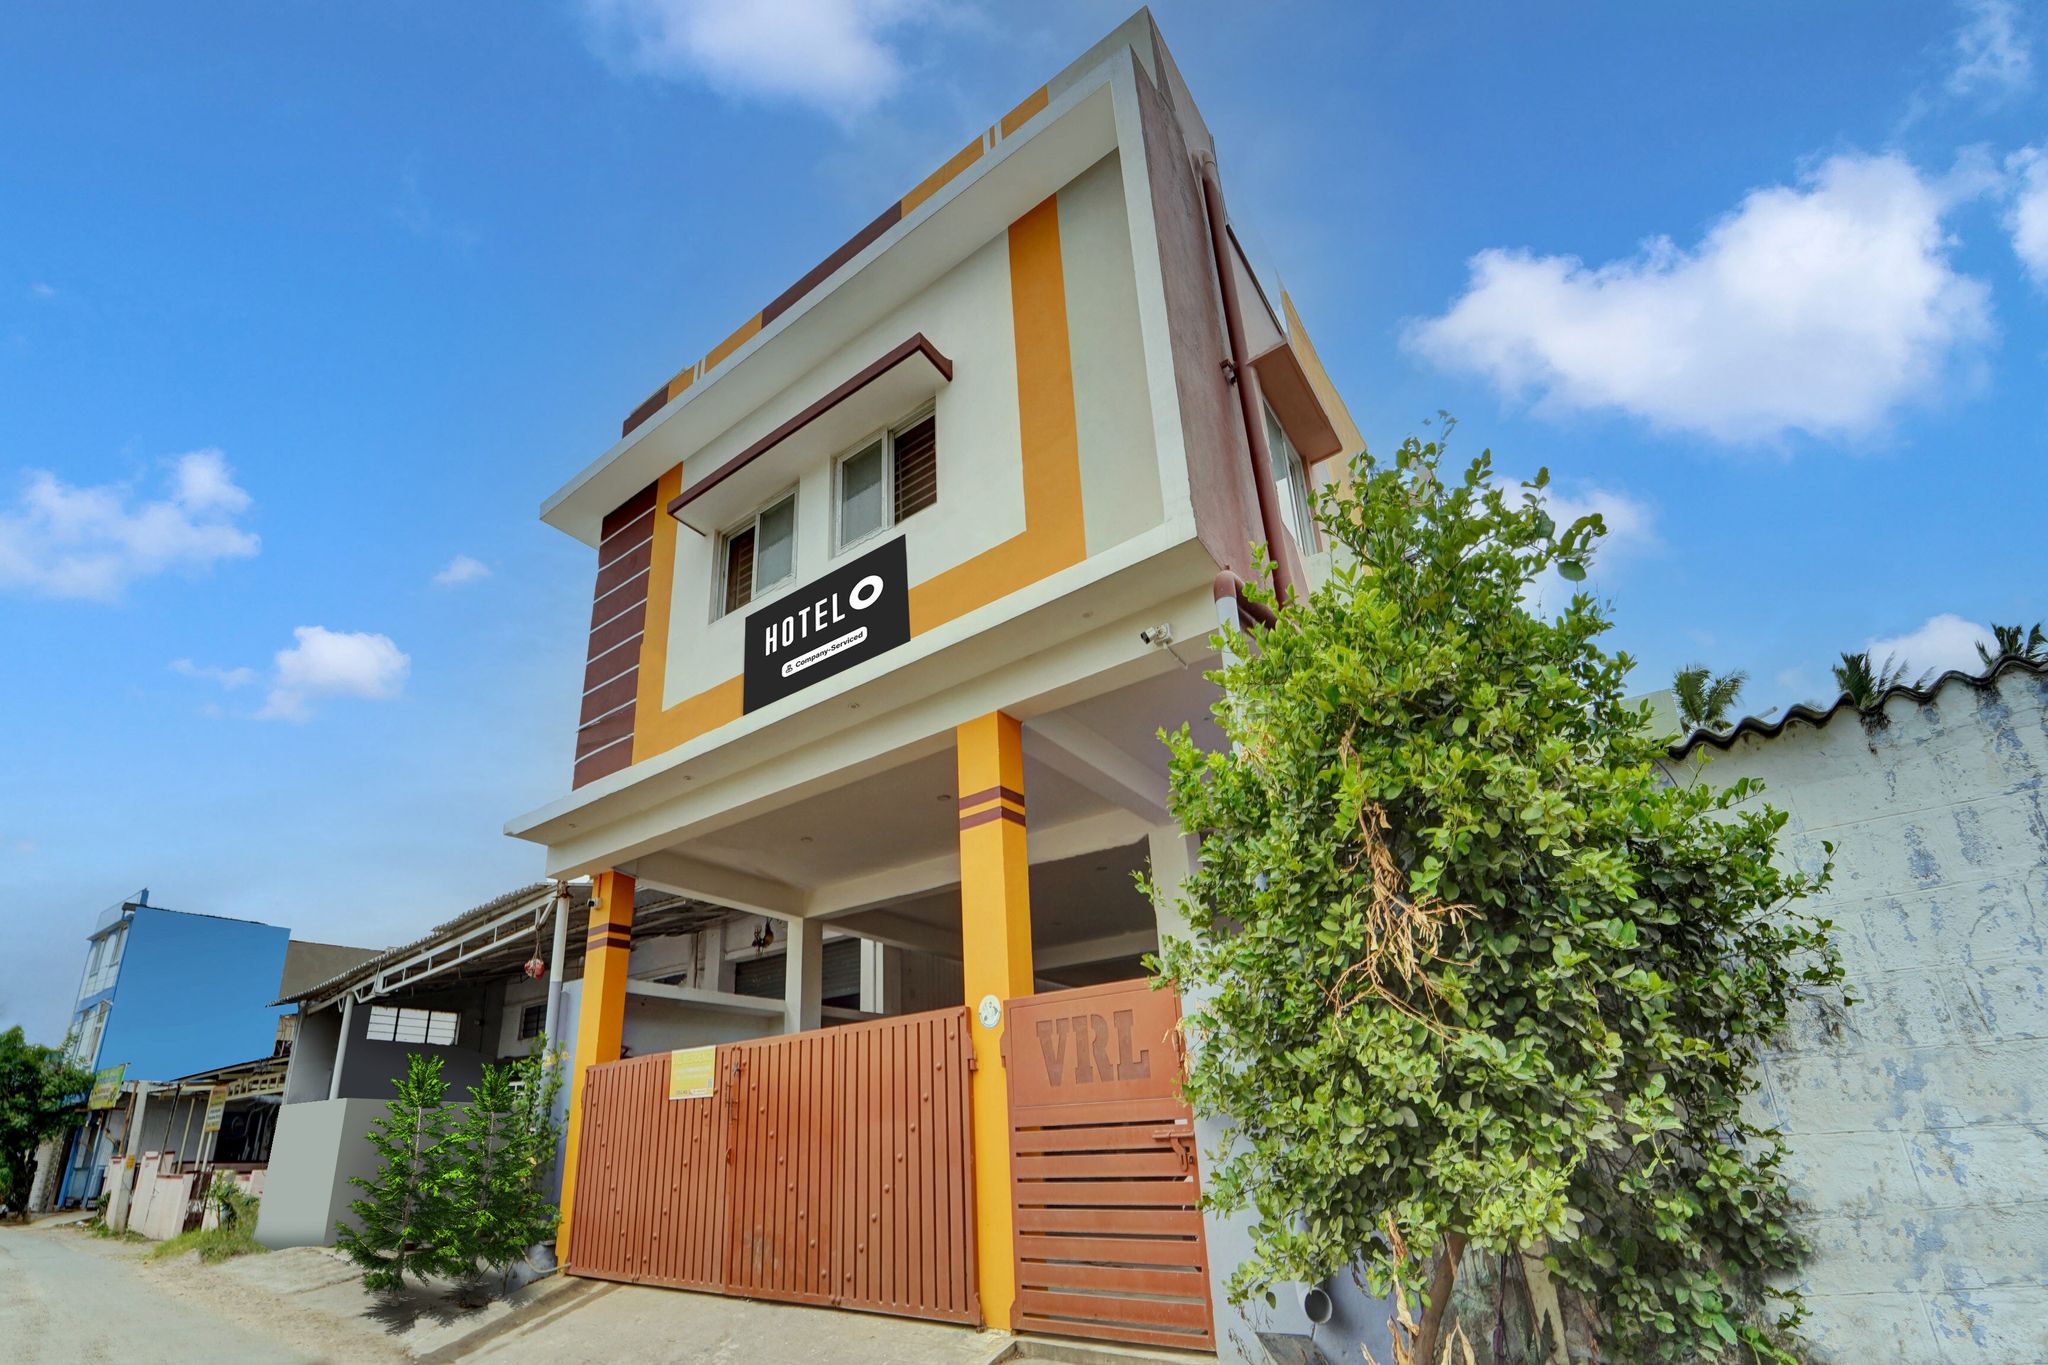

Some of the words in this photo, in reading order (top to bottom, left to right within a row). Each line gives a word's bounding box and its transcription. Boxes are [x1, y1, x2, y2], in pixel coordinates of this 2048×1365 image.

[765, 593, 846, 656] HOTEL
[795, 631, 864, 668] Company-Serviced
[1036, 1009, 1150, 1087] VRL
